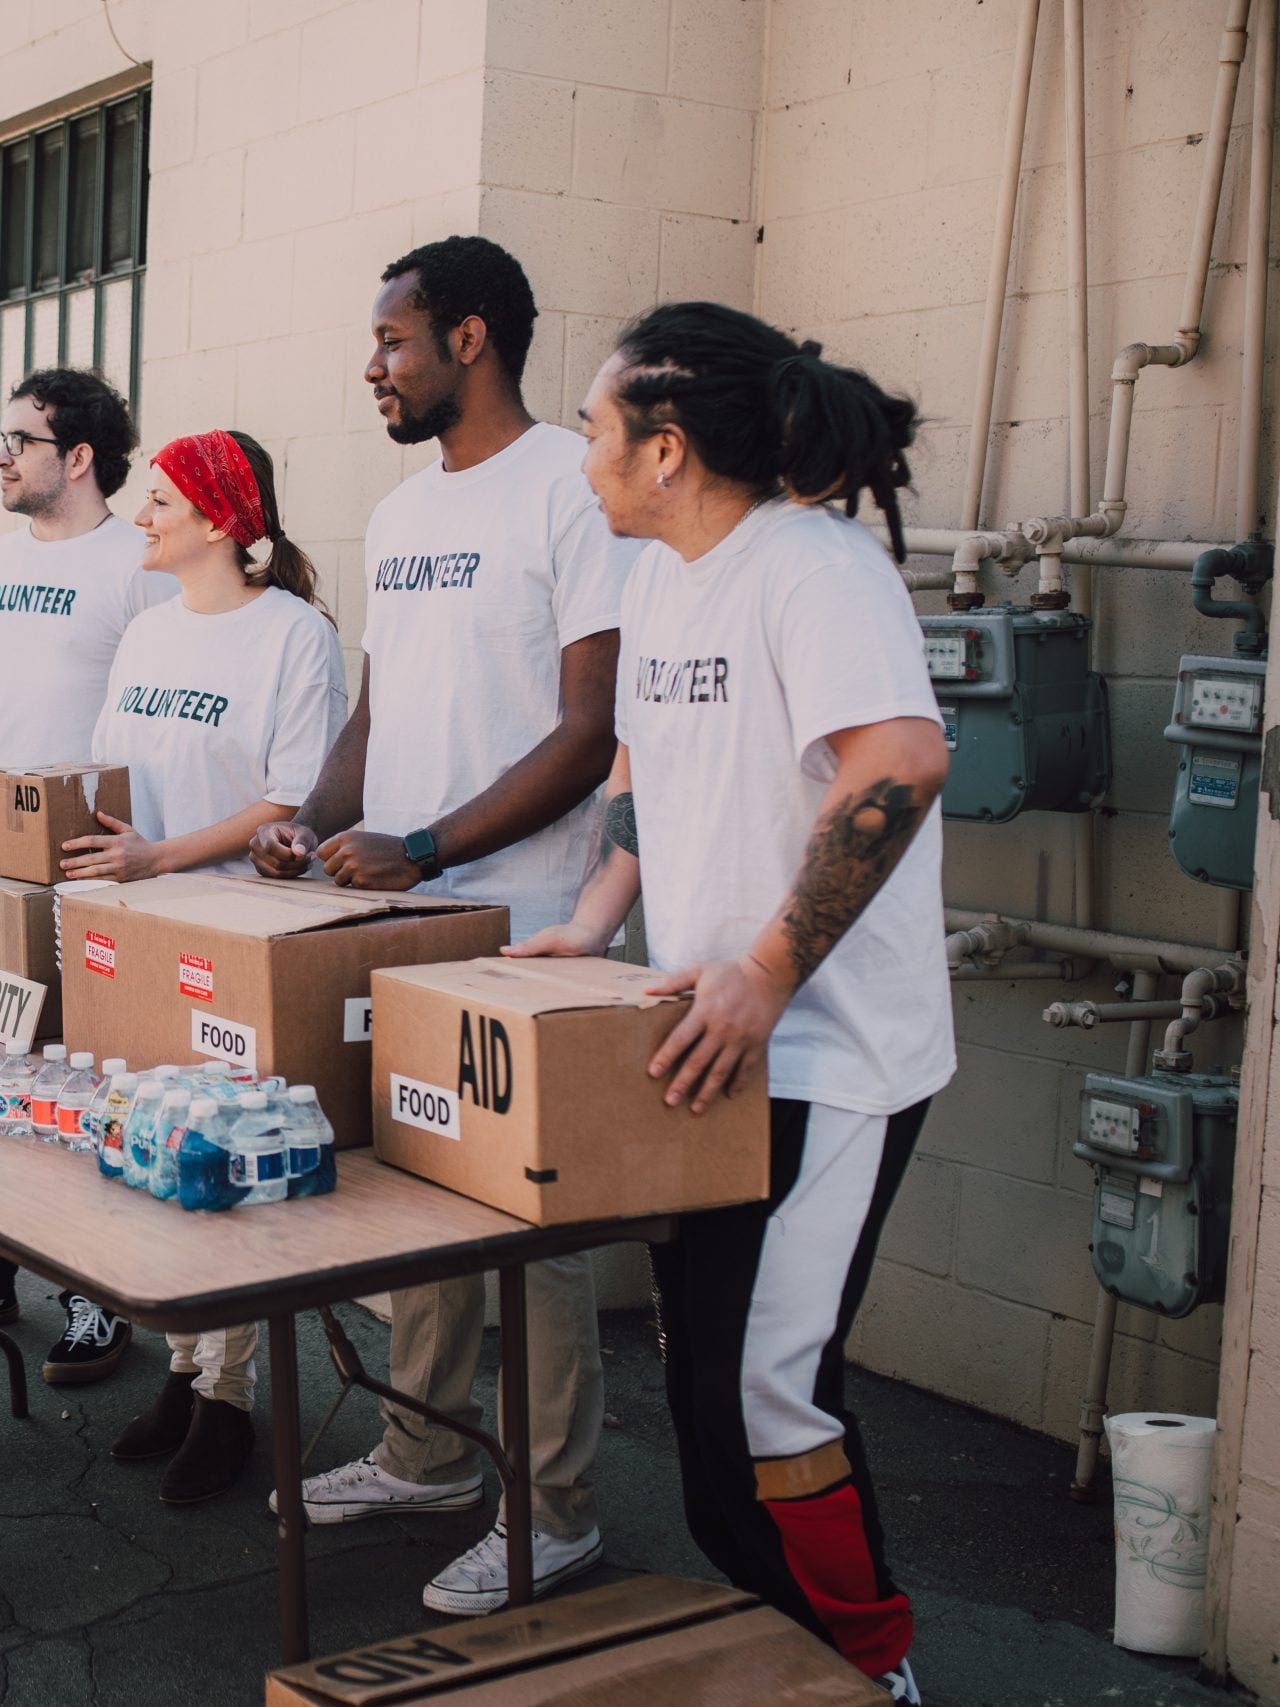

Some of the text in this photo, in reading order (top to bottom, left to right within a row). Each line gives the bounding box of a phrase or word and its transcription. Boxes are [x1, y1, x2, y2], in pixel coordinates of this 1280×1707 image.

[375, 552, 481, 592] VOLUNTEER
[116, 686, 229, 728] VOLUNTEER
[14, 784, 41, 813] AID
[88, 945, 113, 964] FRAGILE
[182, 968, 210, 987] FRAGILE
[201, 1021, 246, 1056] FOOD
[458, 1009, 513, 1115] AID
[398, 1084, 450, 1126] FOOD
[315, 1638, 474, 1687] AID
